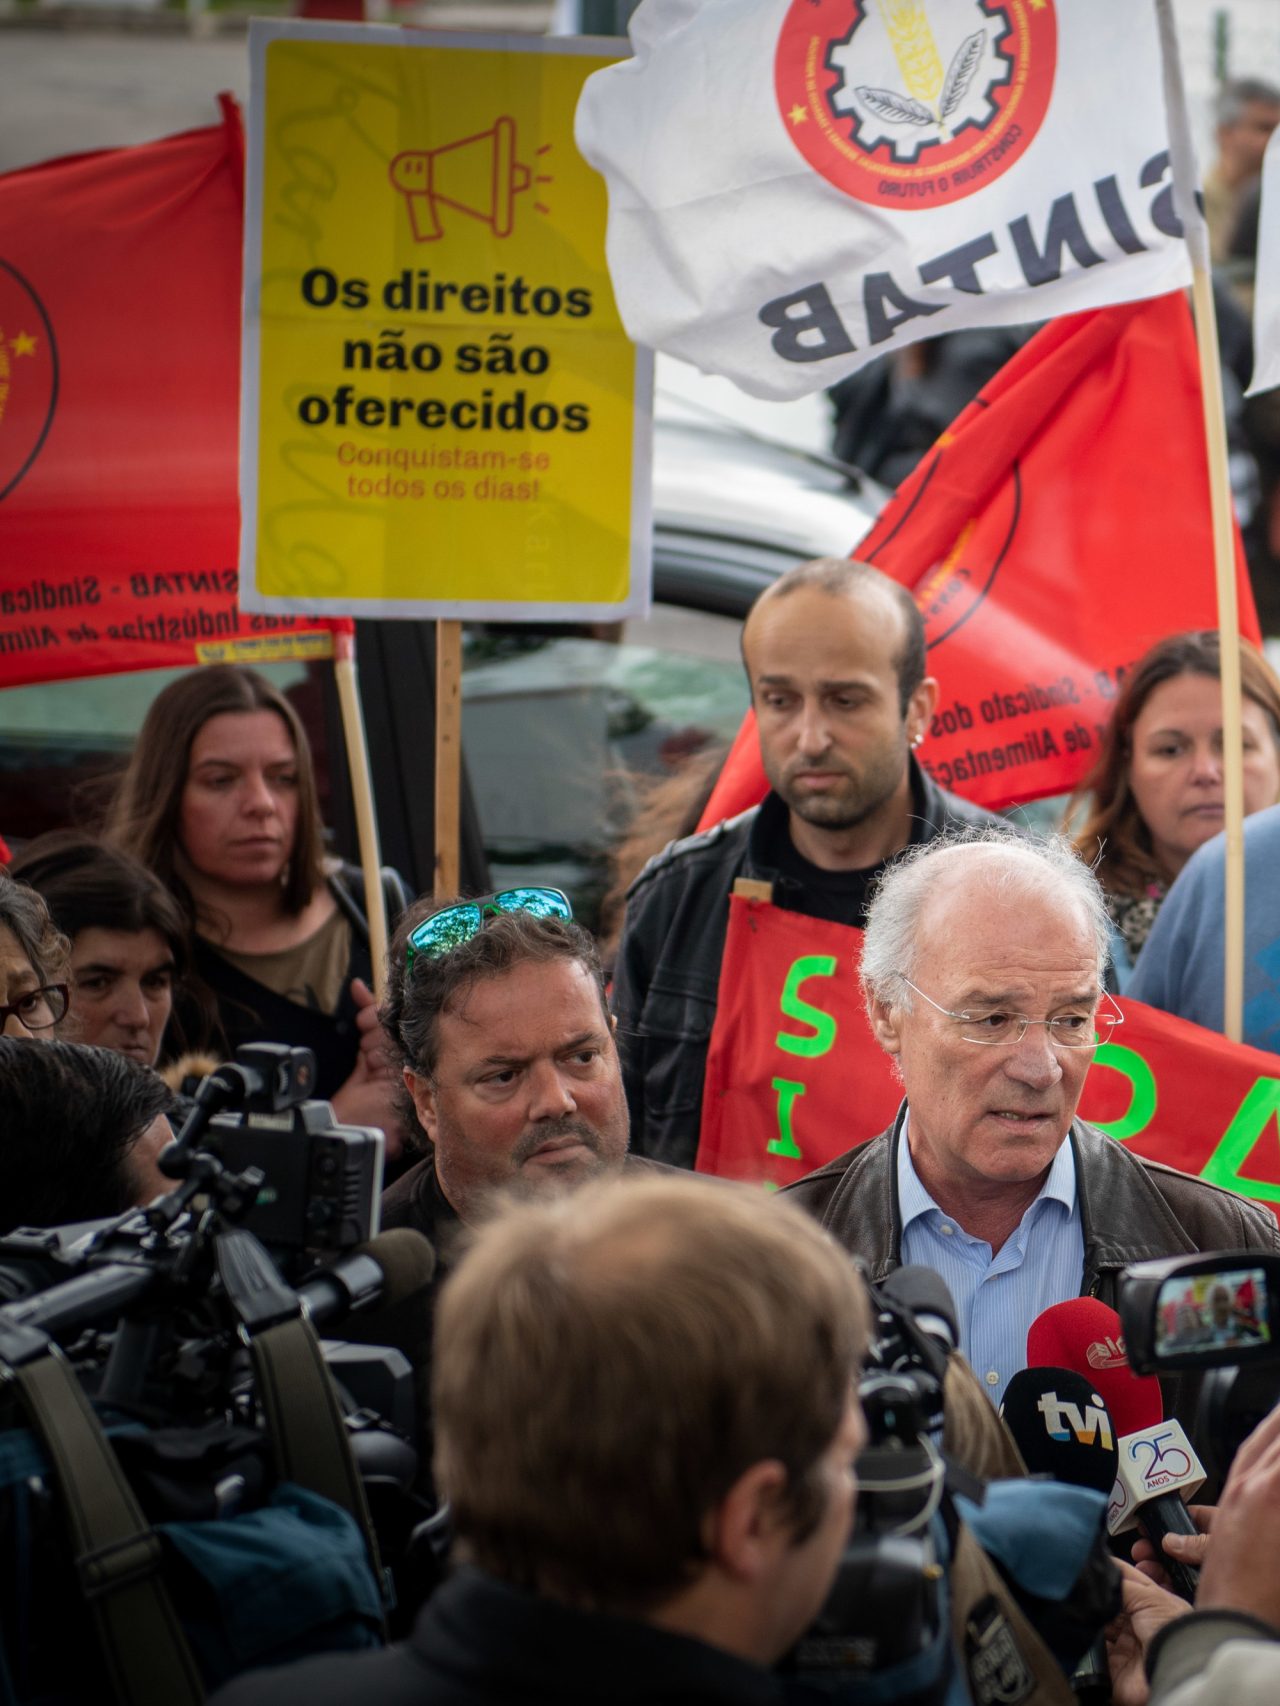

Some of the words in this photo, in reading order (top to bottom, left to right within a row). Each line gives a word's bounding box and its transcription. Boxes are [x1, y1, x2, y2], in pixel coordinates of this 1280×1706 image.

[301, 266, 369, 309] Os
[383, 269, 593, 318] direitos
[343, 328, 442, 372] não
[455, 332, 551, 375] são
[298, 384, 591, 433] oferecidos
[337, 441, 552, 473] Conquistam-se
[346, 472, 426, 499] todos
[433, 478, 465, 500] os
[474, 475, 540, 501] dias!
[1037, 1390, 1114, 1451] tvi
[1132, 1432, 1191, 1479] 25
[1147, 1476, 1170, 1489] ANOS
